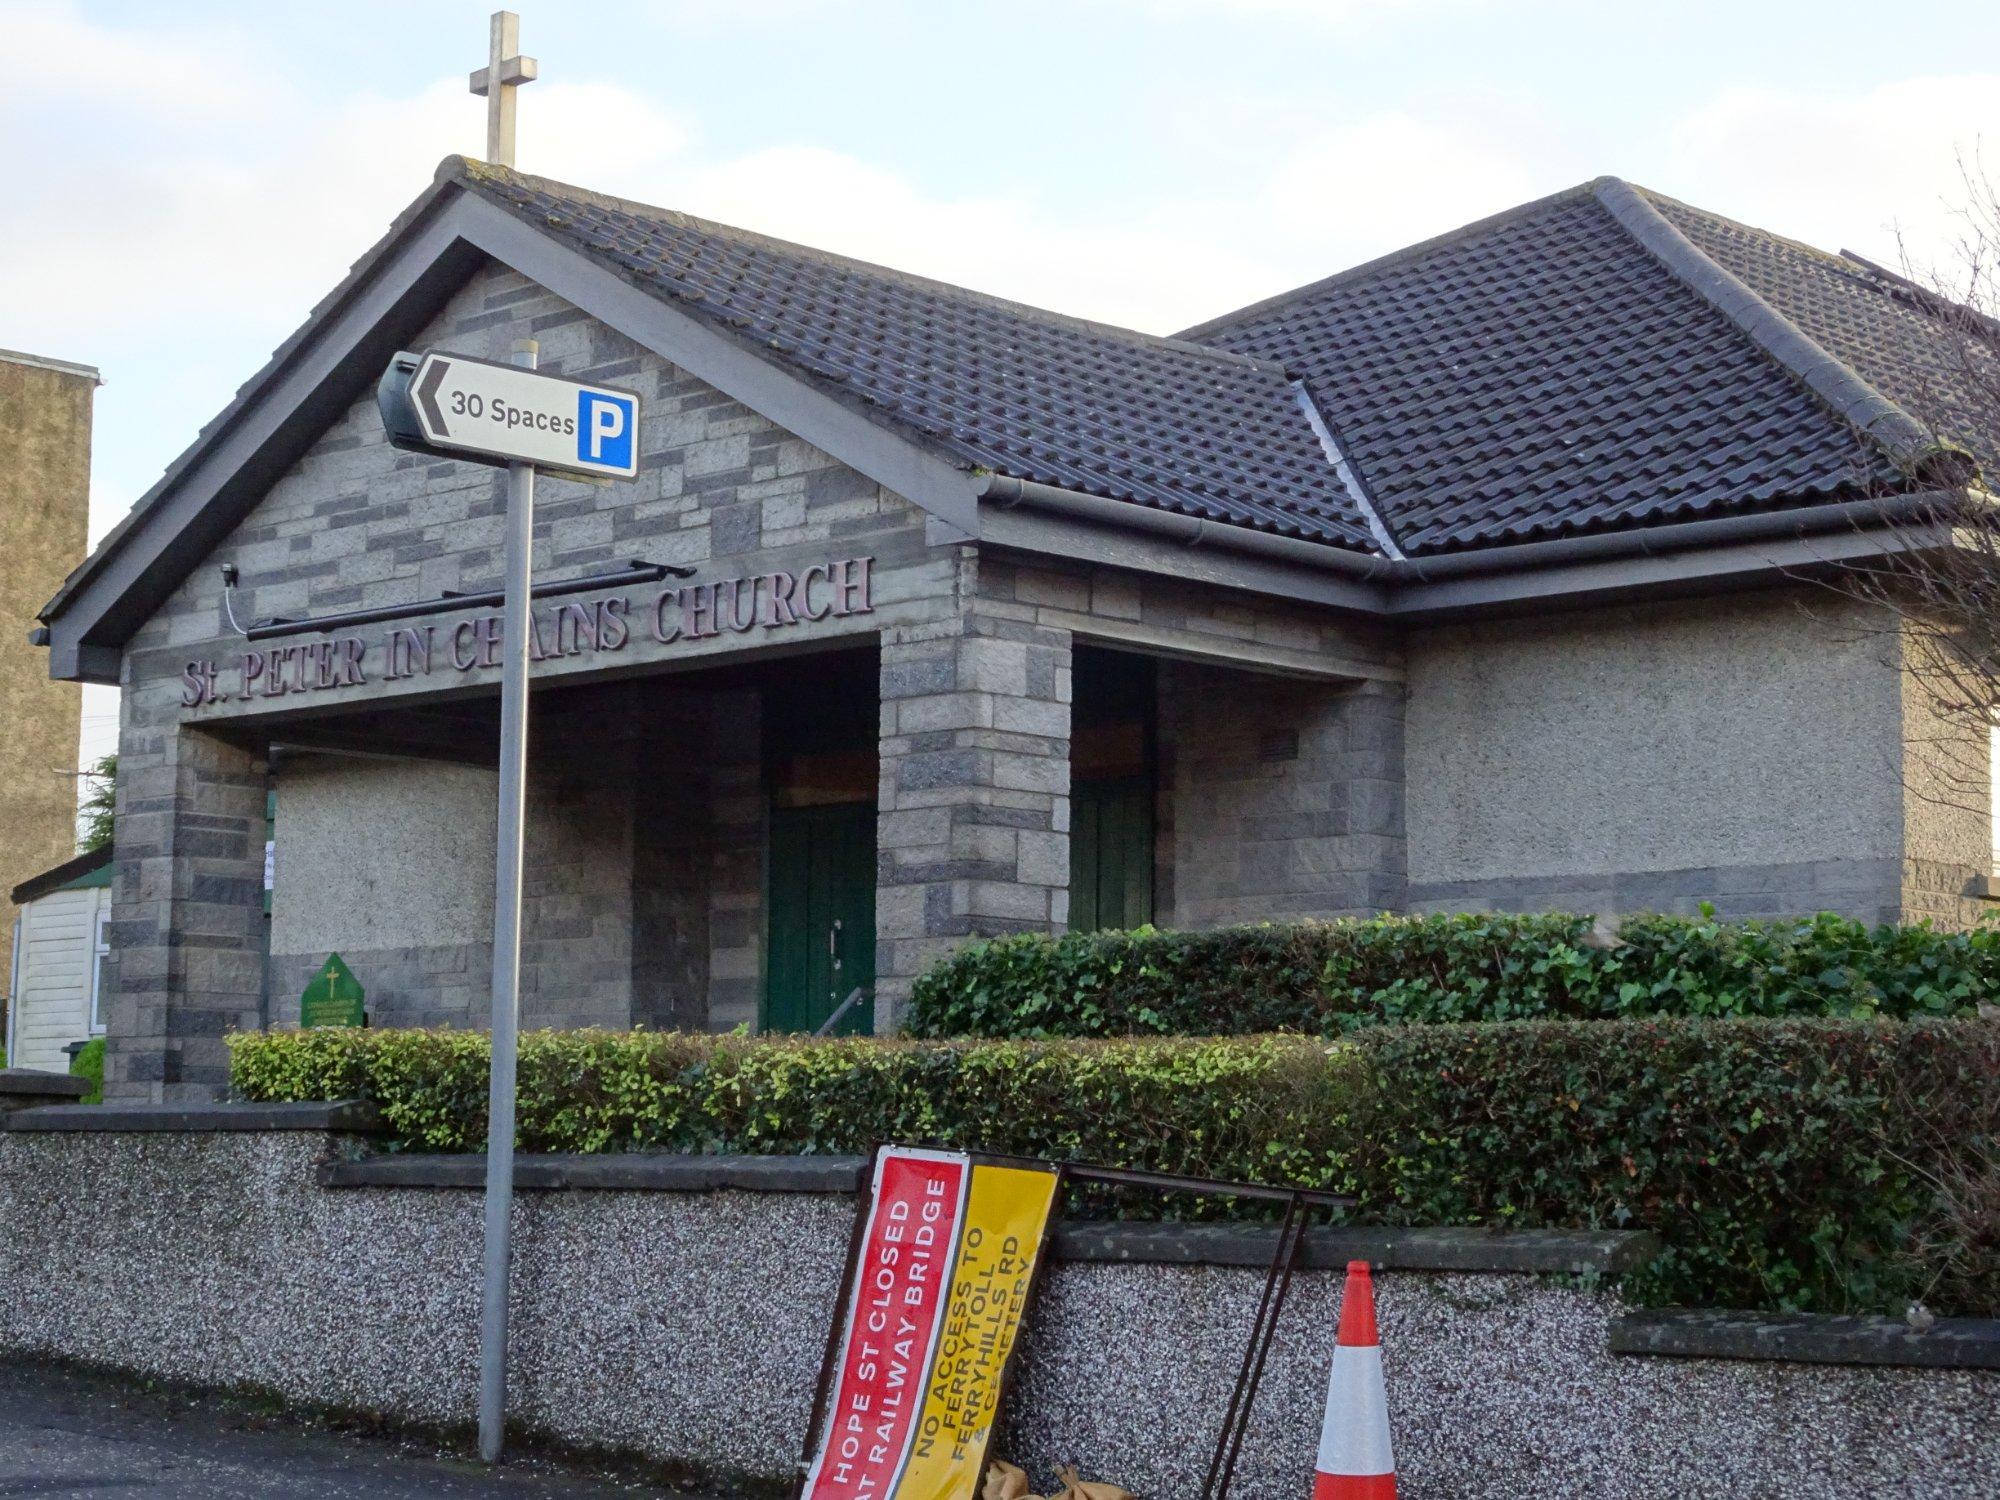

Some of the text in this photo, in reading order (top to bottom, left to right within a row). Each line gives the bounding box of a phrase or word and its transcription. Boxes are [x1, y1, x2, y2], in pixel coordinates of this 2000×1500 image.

[451, 390, 574, 435] 30 Spaces
[590, 400, 623, 458] P
[239, 637, 367, 700] PETER
[383, 625, 435, 681] IN
[650, 556, 876, 644] CHURCH
[834, 1200, 909, 1483] HOPE ST CLOSED
[868, 1316, 916, 1464] RAILWAY
[904, 1179, 945, 1305] BRIDGE
[916, 1227, 982, 1458] NO ACCESS TO
[942, 1264, 995, 1429] FERRYTOLL
[951, 1236, 1018, 1461] FERRYHILLS RD
[984, 1257, 1030, 1411] CEETERY
